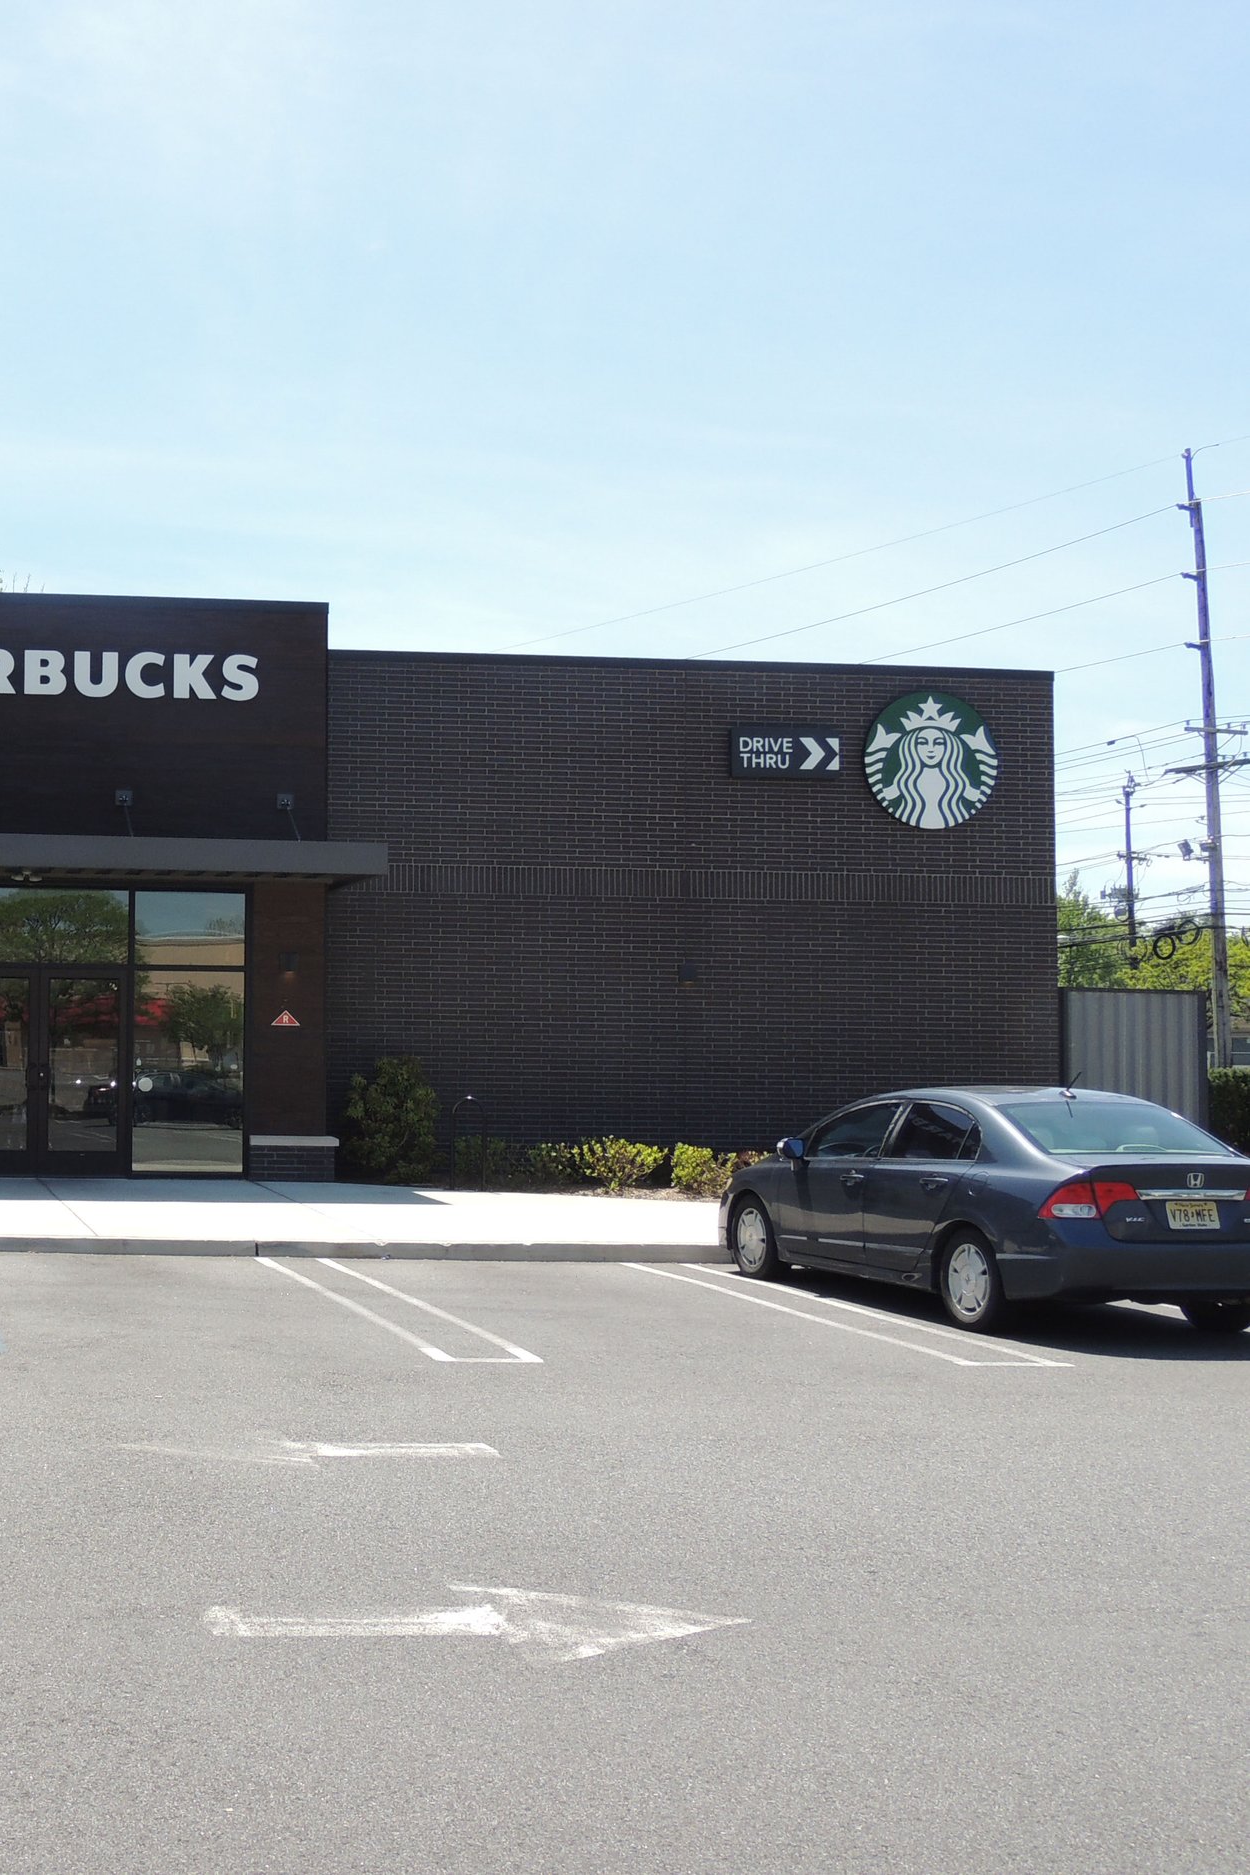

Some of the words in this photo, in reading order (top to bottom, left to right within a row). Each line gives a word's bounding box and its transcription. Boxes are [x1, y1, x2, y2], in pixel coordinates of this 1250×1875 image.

[739, 736, 794, 753] DRIVE
[739, 753, 791, 769] THRU
[282, 1014, 290, 1024] R
